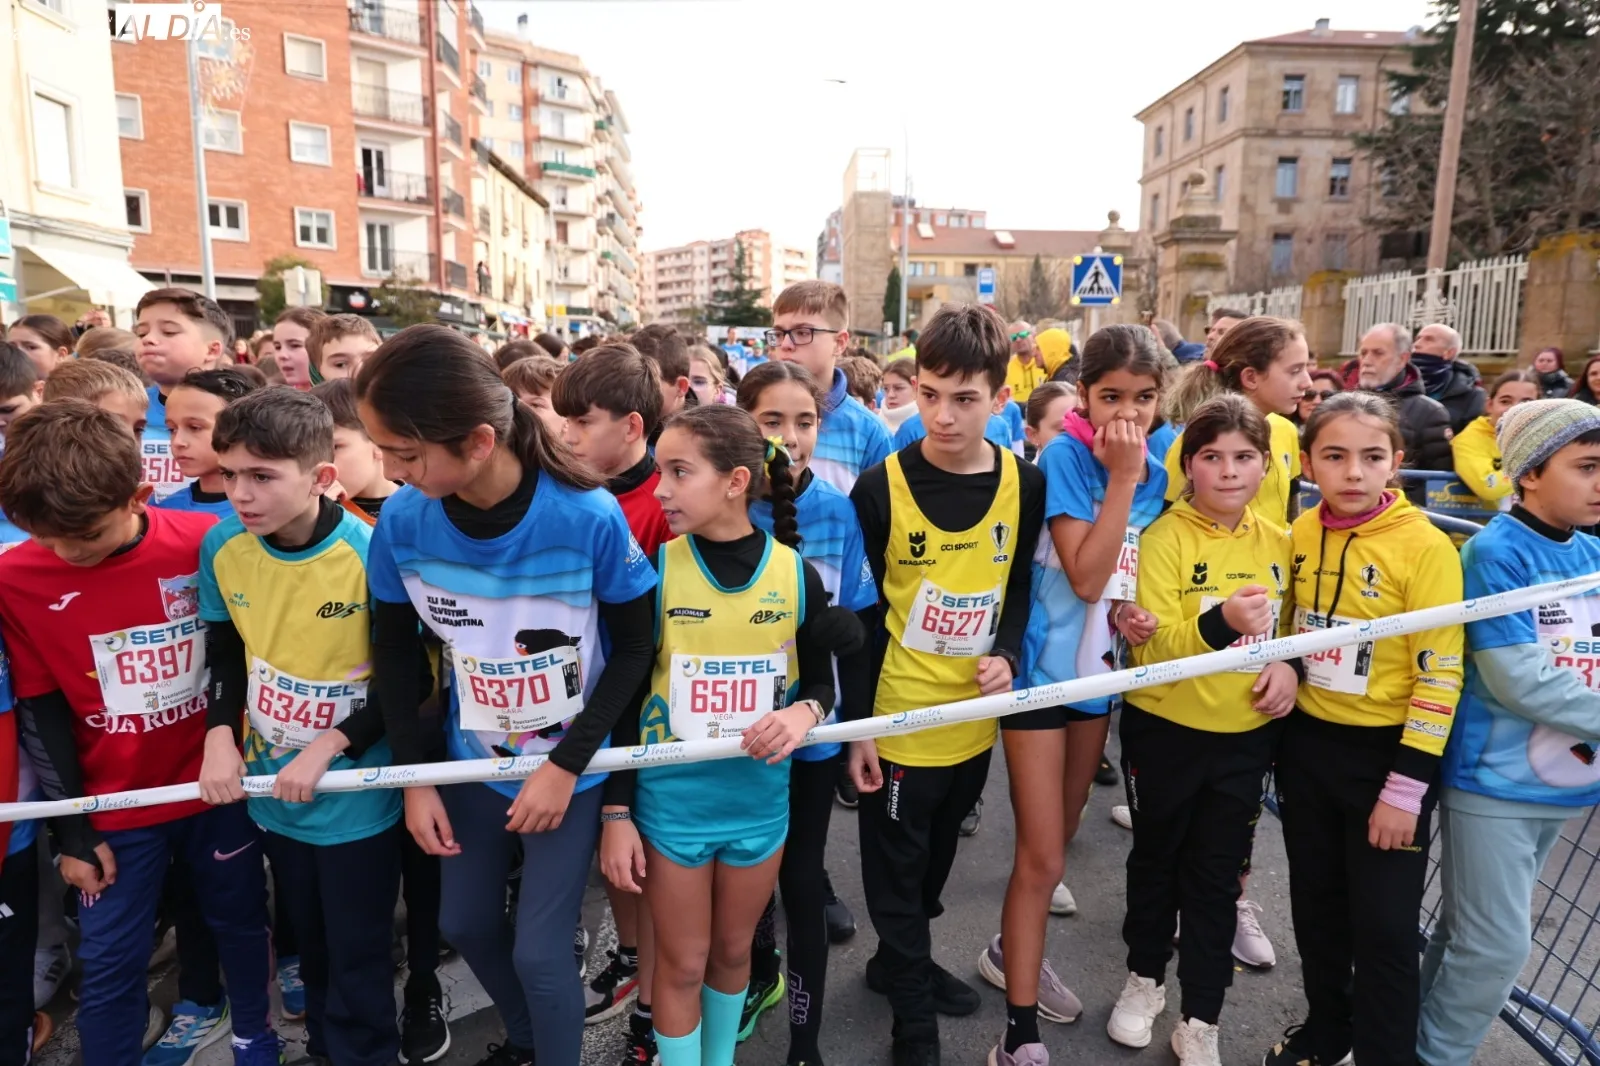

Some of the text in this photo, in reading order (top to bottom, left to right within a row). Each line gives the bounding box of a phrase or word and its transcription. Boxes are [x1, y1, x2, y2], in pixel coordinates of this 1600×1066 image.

[942, 593, 995, 608] SETEL
[130, 617, 207, 645] SETEL
[921, 604, 986, 636] 6527
[116, 639, 194, 685] 6397
[479, 653, 564, 676] SETEL
[704, 660, 777, 675] SETEL
[277, 675, 355, 698] SETEL
[469, 673, 550, 708] 6370
[690, 679, 757, 713] 6510
[143, 690, 209, 733] RURA
[257, 684, 336, 730] 6349
